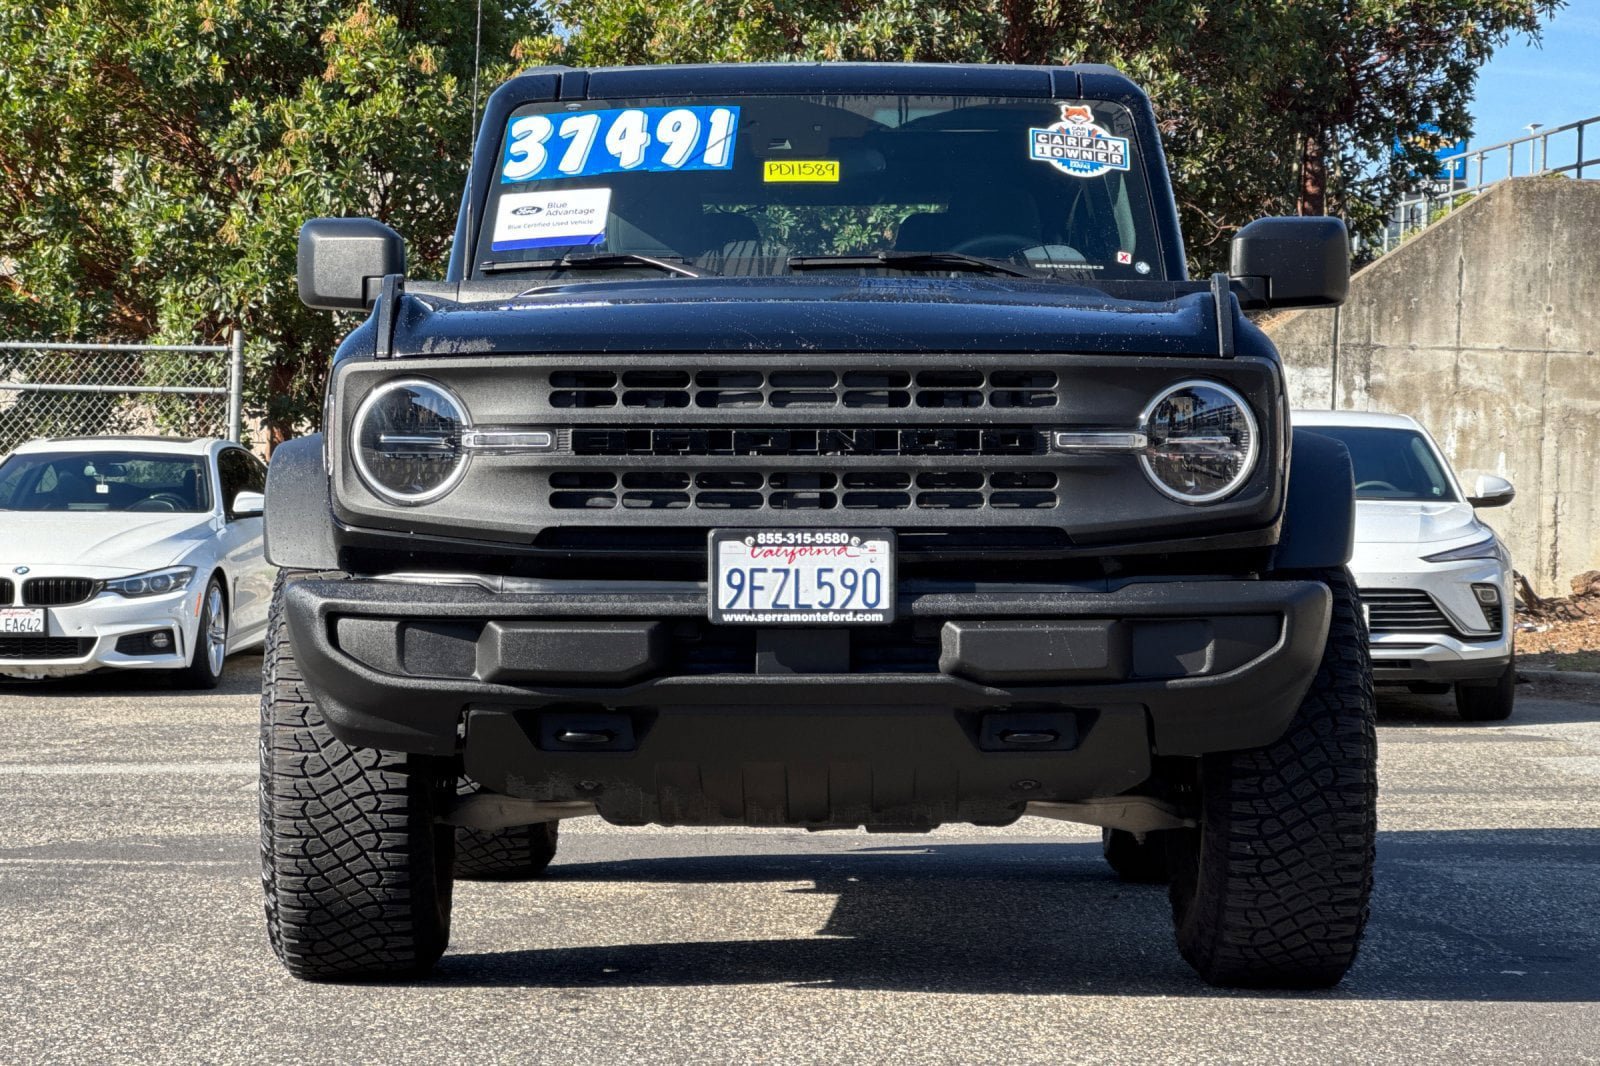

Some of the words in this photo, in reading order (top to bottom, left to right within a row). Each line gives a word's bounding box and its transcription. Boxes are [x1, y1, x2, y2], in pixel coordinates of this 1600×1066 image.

[503, 108, 737, 180] 37491
[1036, 134, 1121, 153] CARFAX
[1039, 146, 1047, 155] 1
[1051, 147, 1123, 164] OWNER
[545, 208, 595, 217] Advantage
[757, 533, 849, 544] 855-315-9580
[750, 545, 860, 564] California
[726, 567, 881, 609] 9FZL590
[0, 618, 41, 631] EA642
[722, 612, 884, 622] www.serramonteford.com
